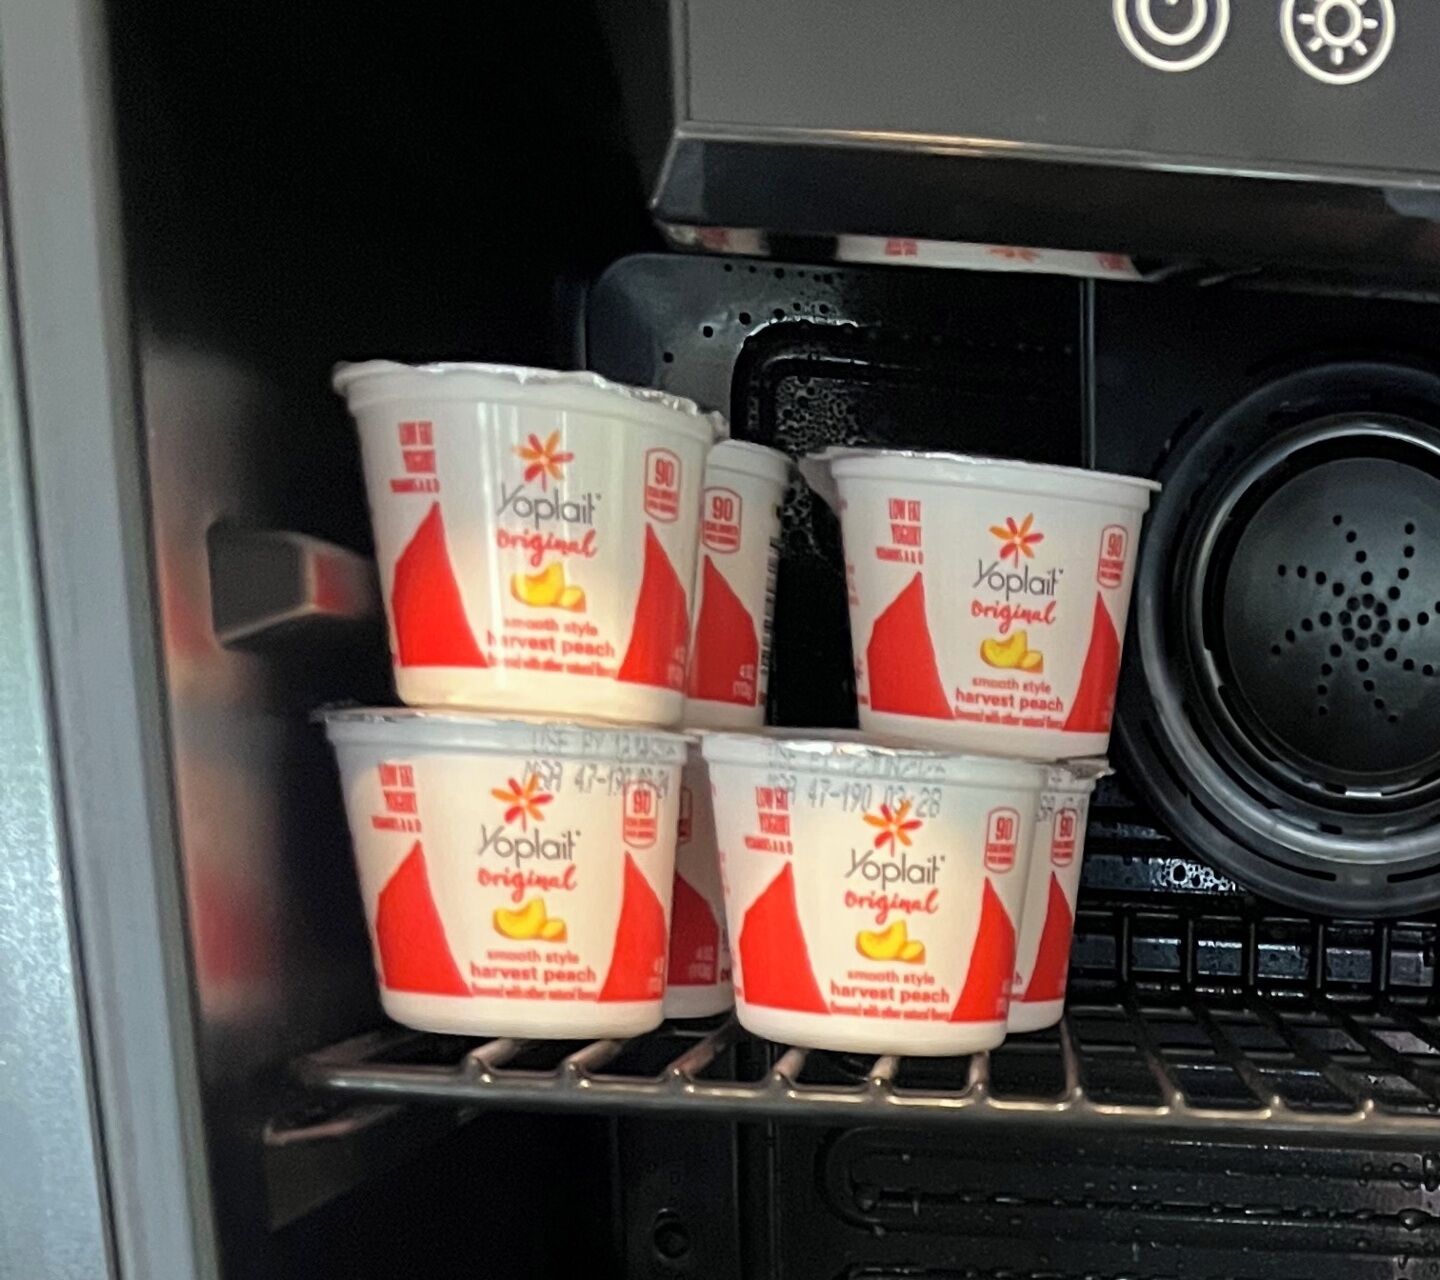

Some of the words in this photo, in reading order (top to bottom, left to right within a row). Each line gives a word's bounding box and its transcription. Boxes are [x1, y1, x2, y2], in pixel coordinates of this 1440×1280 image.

[655, 457, 674, 488] 90
[496, 482, 597, 530] Yoplait
[711, 497, 734, 522] 90
[972, 559, 1060, 602] Yoplait
[563, 620, 598, 637] style
[562, 635, 615, 658] peach
[973, 676, 1020, 691] smooth
[1023, 679, 1053, 695] style
[955, 687, 1015, 709] harvest
[1020, 692, 1065, 713] peach
[995, 816, 1013, 840] 90
[478, 824, 576, 868] Yoplait
[844, 848, 939, 891] Yoplait
[487, 949, 541, 964] smooth
[545, 951, 580, 967] style
[470, 960, 538, 983] harvest
[543, 965, 597, 985] peach
[847, 970, 900, 986] smooth
[903, 971, 936, 987] style
[829, 980, 895, 1002] harvest
[900, 984, 951, 1005] peach
